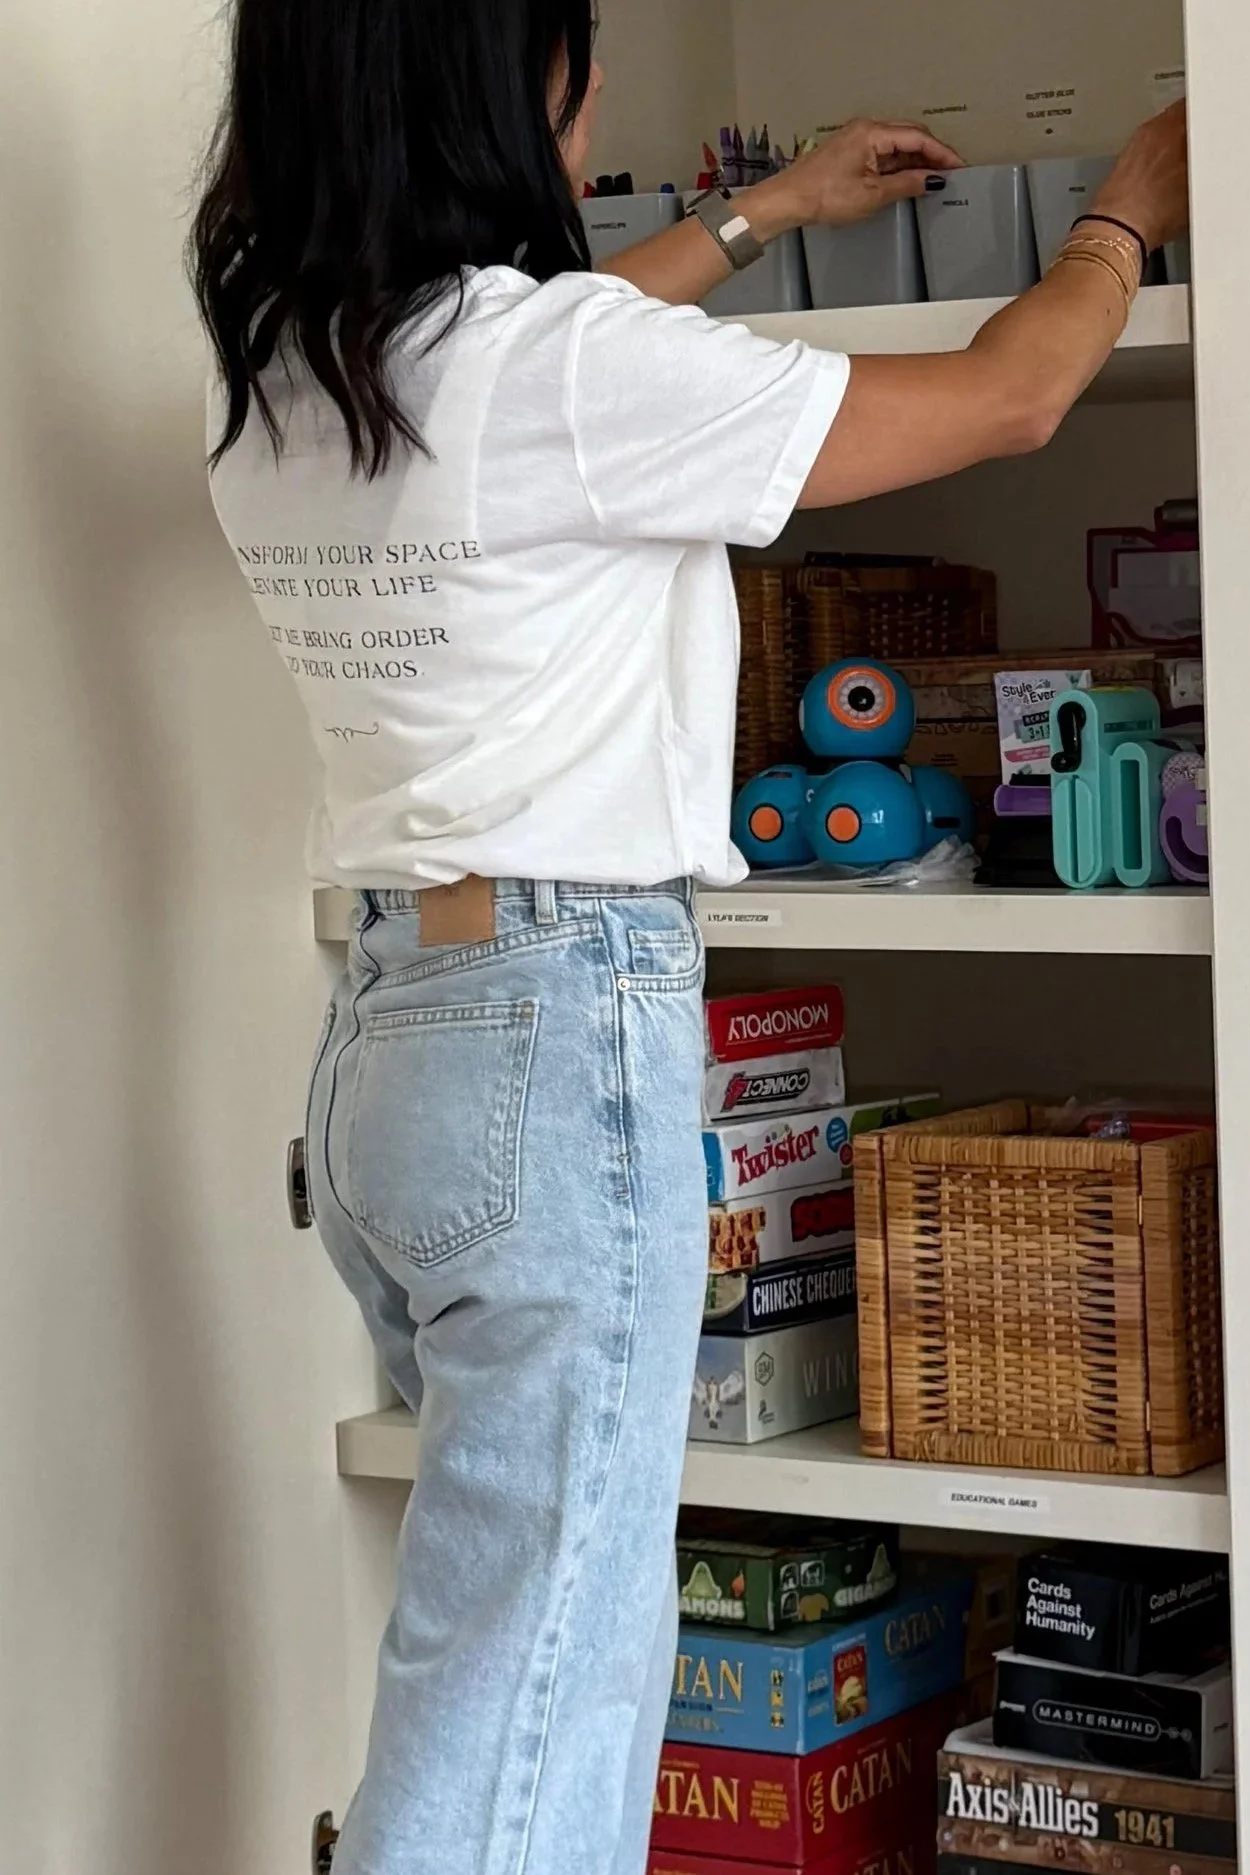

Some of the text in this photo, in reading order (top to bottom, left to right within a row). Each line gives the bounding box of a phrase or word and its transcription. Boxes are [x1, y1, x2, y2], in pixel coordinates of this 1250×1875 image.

[317, 545, 373, 565] YOUR
[385, 540, 482, 564] SPACE
[304, 578, 362, 598] YOUR
[371, 575, 437, 597] LIFE
[303, 629, 352, 649] BRING
[361, 627, 450, 649] ORDER
[304, 658, 336, 679] YOUR
[1002, 682, 1033, 698] Style
[1029, 690, 1057, 704] Ever
[728, 1003, 829, 1041] MONOPOLY
[742, 1072, 810, 1098] CONNECT
[731, 1124, 819, 1187] Twister
[752, 1276, 804, 1316] CHINESE
[951, 1493, 1038, 1508] EDUCATIONAL GAMES
[1027, 1577, 1072, 1600] Cards
[1149, 1587, 1178, 1610] Cards
[1026, 1594, 1082, 1620] Against
[1025, 1610, 1096, 1641] Humanity
[1039, 1706, 1156, 1735] MASTERMIND
[830, 1738, 912, 1814] CATAN
[946, 1771, 1009, 1825] Axis
[1019, 1782, 1100, 1838] Allies
[1114, 1808, 1176, 1849] 1941
